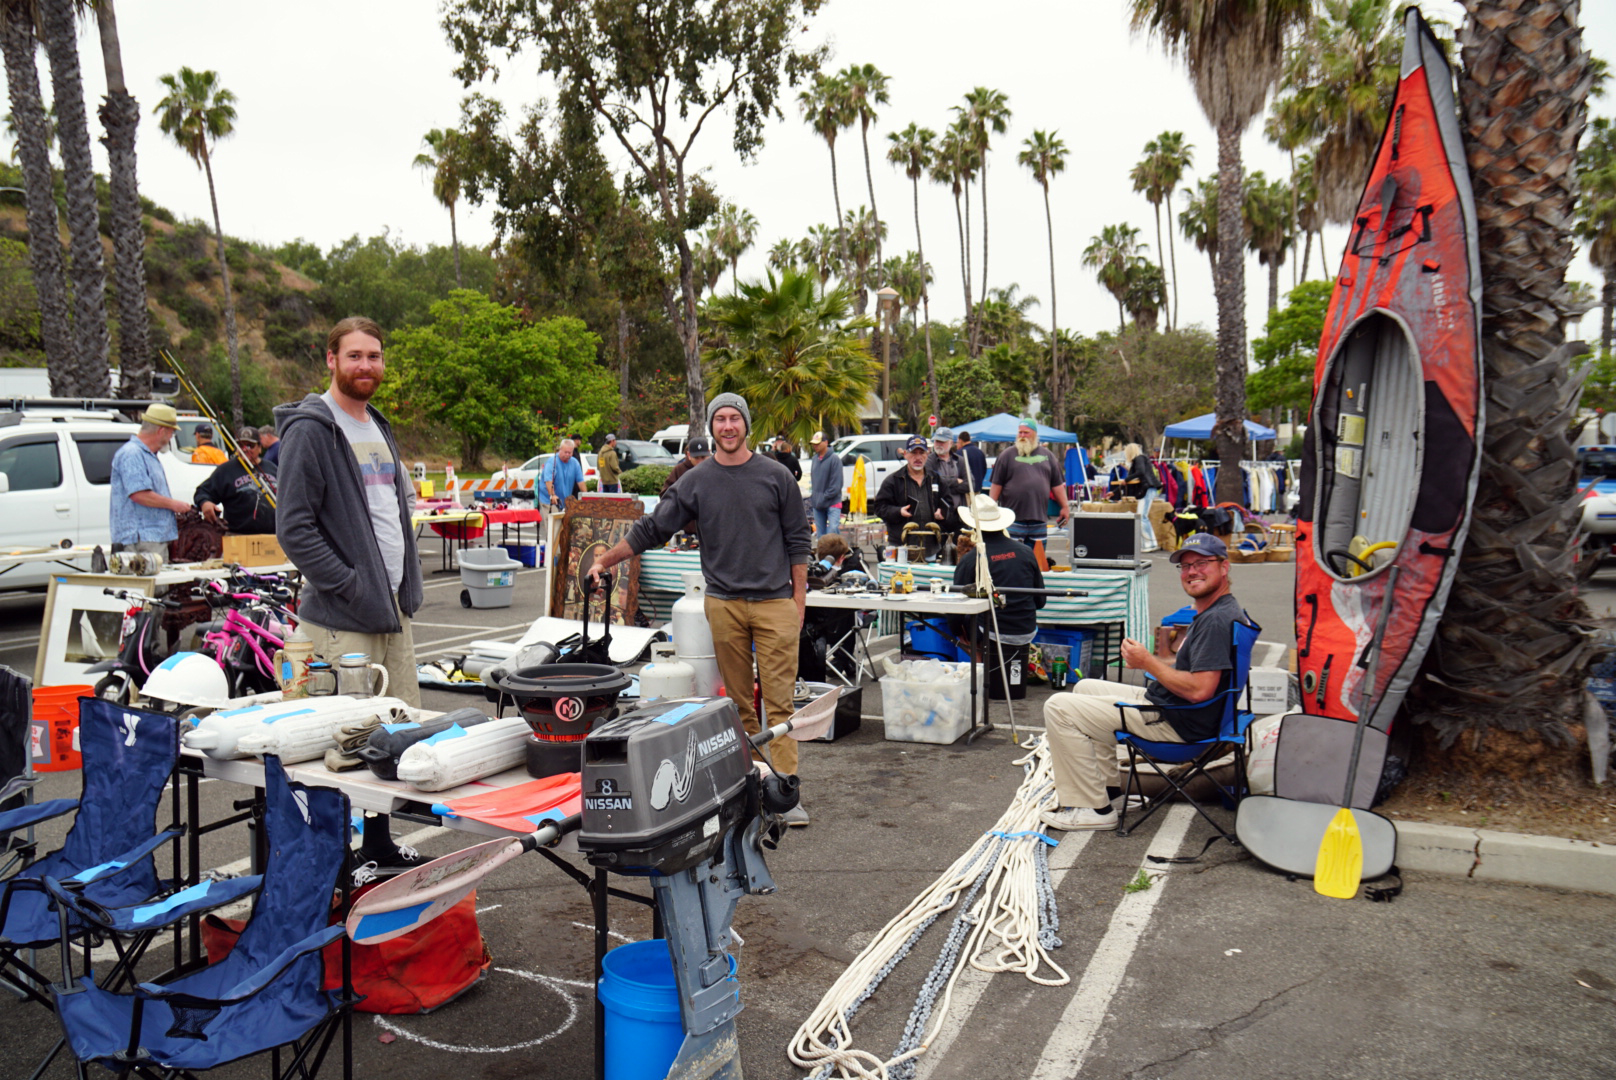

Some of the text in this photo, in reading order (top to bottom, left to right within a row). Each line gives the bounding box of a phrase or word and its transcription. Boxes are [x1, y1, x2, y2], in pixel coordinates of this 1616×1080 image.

[698, 726, 737, 757] NISSAN
[601, 779, 613, 796] 8
[585, 798, 632, 810] NISSAN
